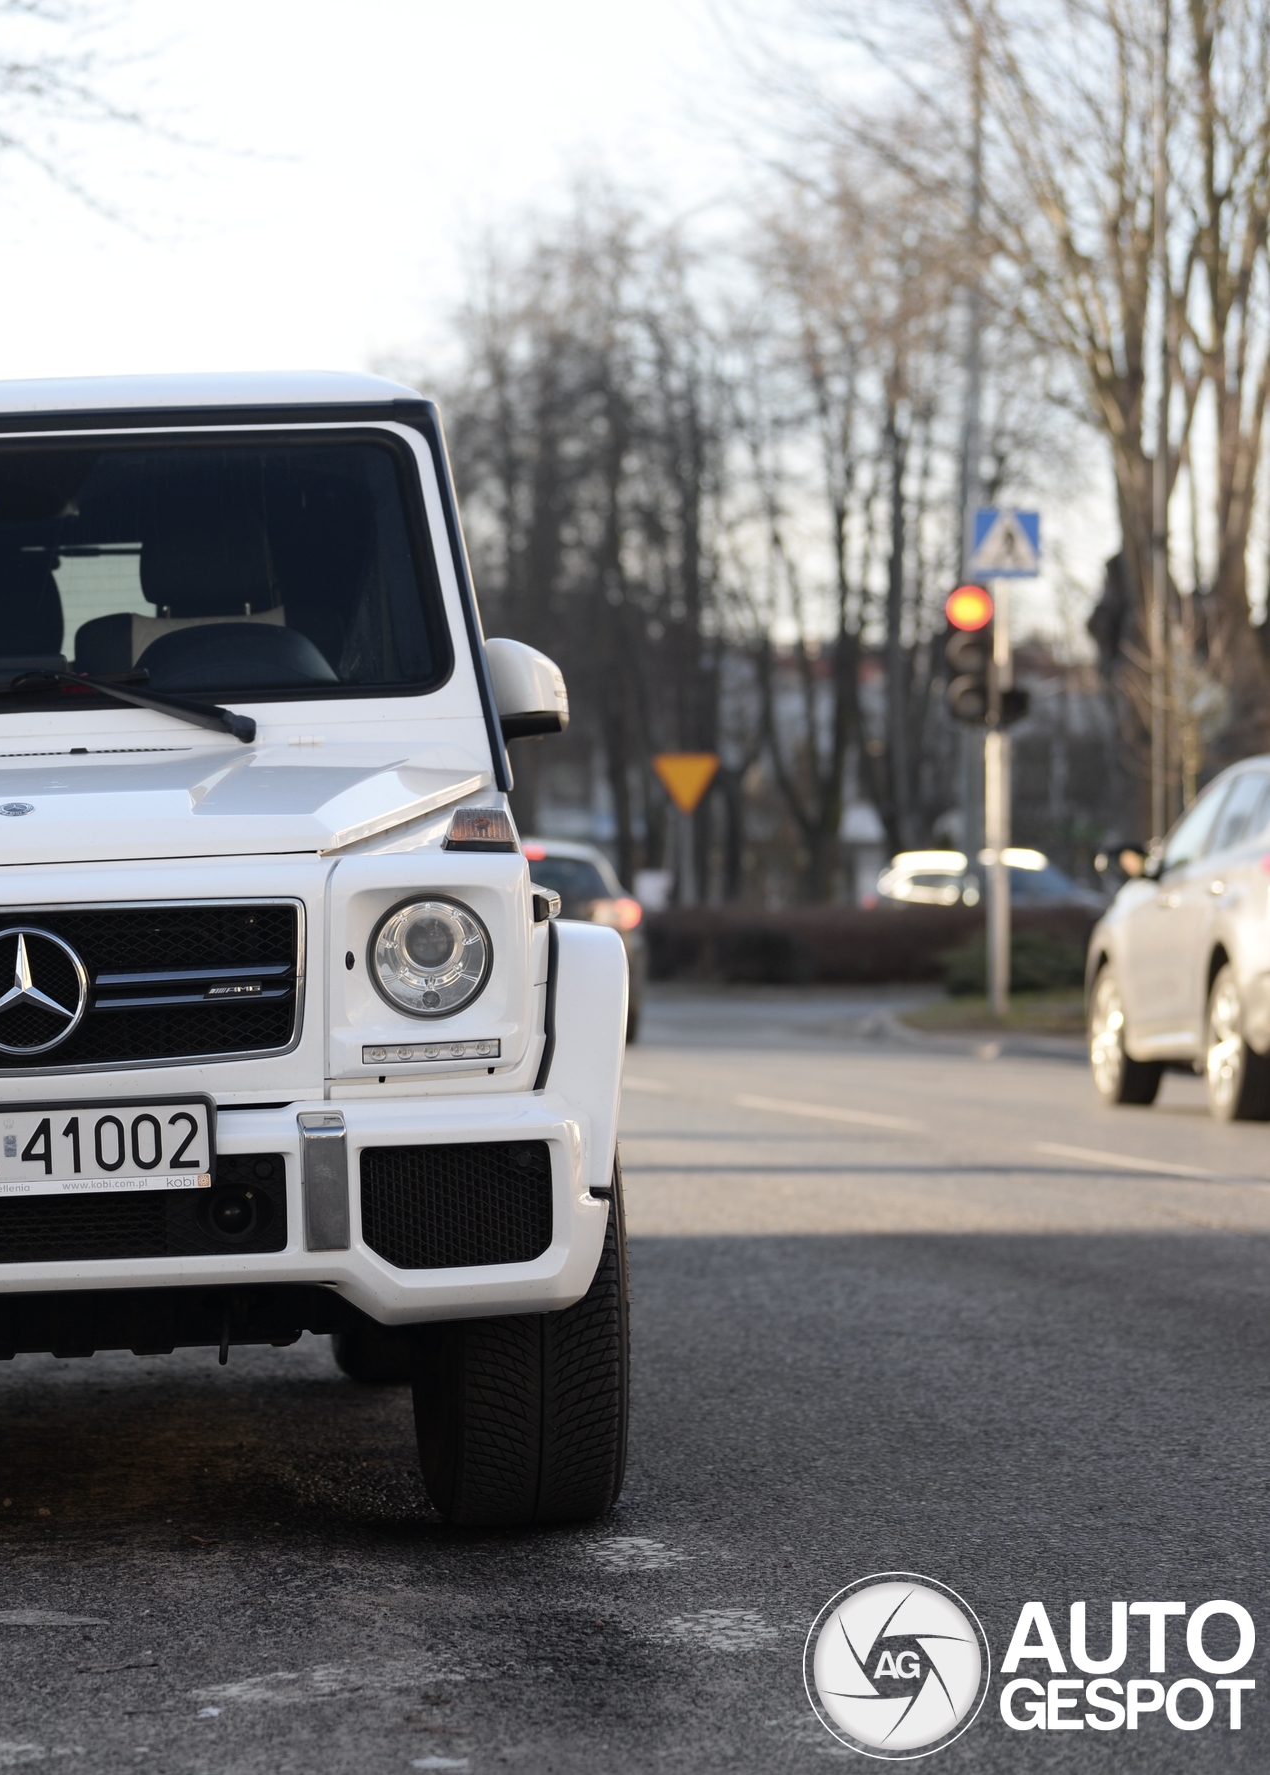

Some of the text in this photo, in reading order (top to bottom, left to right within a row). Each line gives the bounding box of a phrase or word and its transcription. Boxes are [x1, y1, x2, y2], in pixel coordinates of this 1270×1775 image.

[225, 985, 261, 994] AMG
[21, 1111, 201, 1175] 41002
[62, 1178, 148, 1190] www.kobi.com.pl
[166, 1176, 195, 1188] kobi
